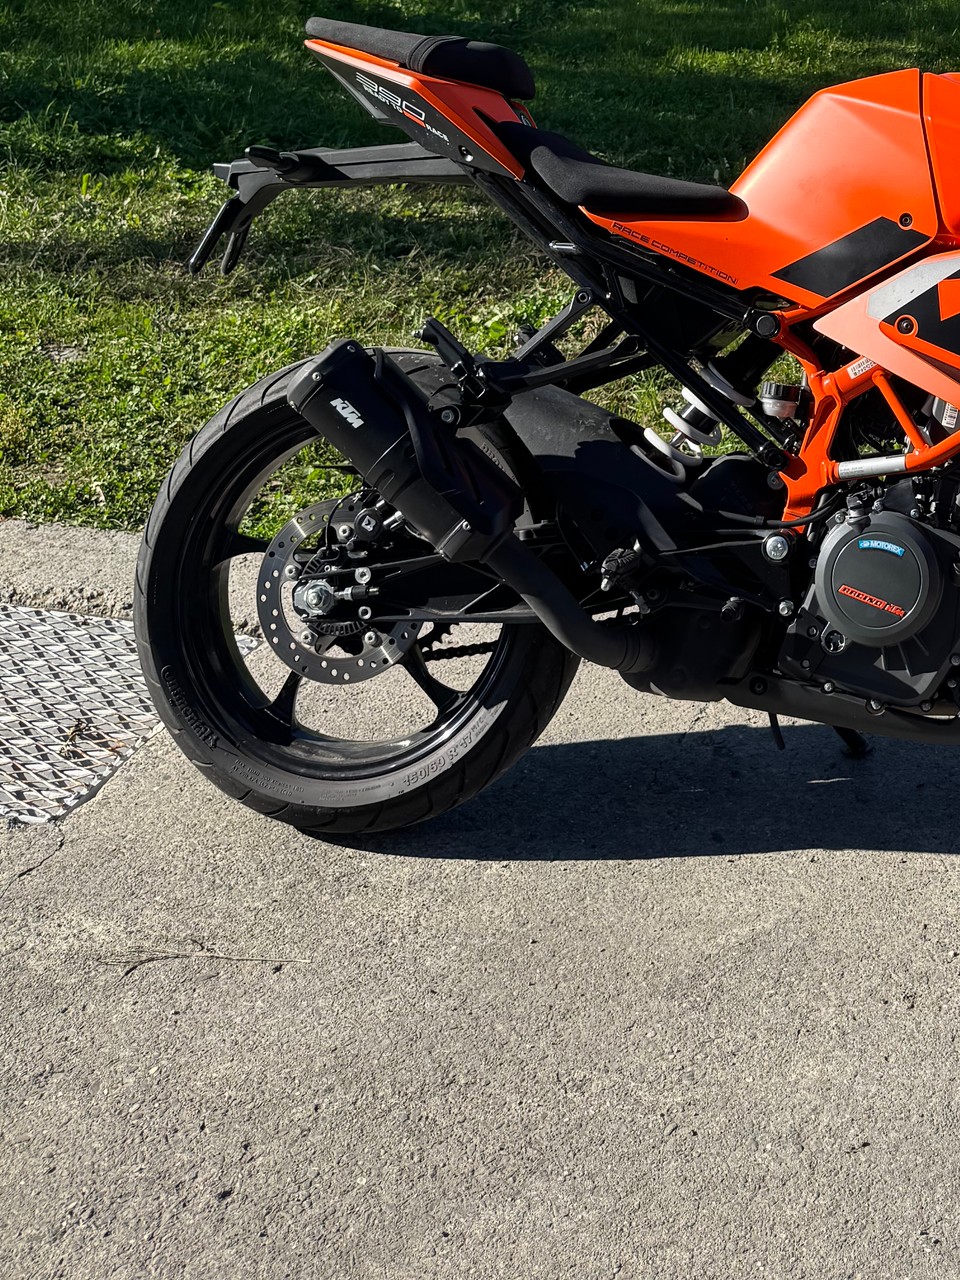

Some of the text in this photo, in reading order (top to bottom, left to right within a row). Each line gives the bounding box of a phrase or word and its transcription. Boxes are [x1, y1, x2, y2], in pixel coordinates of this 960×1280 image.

[355, 71, 425, 121] 390
[612, 221, 738, 285] RACE COMPETITION
[330, 397, 365, 429] KTM
[870, 540, 902, 556] MOTOREX
[840, 585, 886, 610] RACING
